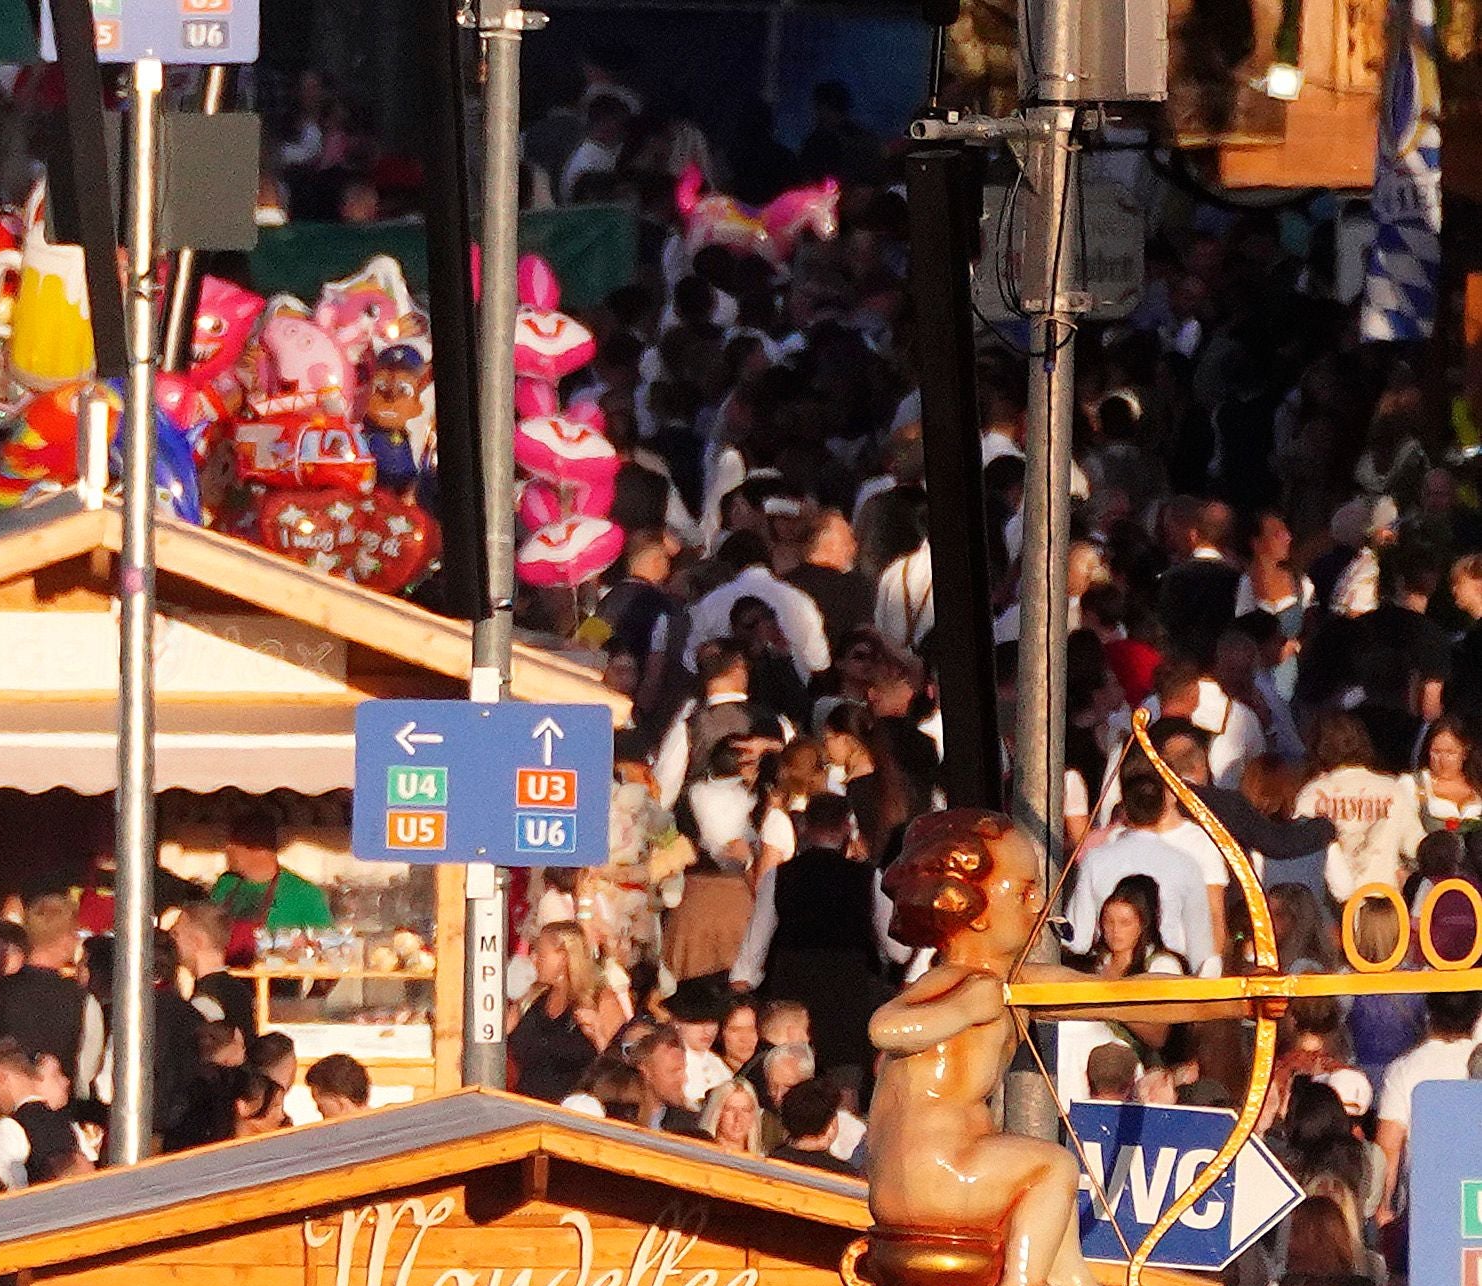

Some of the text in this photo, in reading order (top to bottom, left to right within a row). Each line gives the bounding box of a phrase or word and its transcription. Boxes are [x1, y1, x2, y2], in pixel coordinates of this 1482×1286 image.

[187, 23, 225, 48] U6
[397, 773, 438, 799] U4
[527, 775, 567, 801] U3
[396, 817, 436, 842] U5
[525, 819, 566, 847] U6
